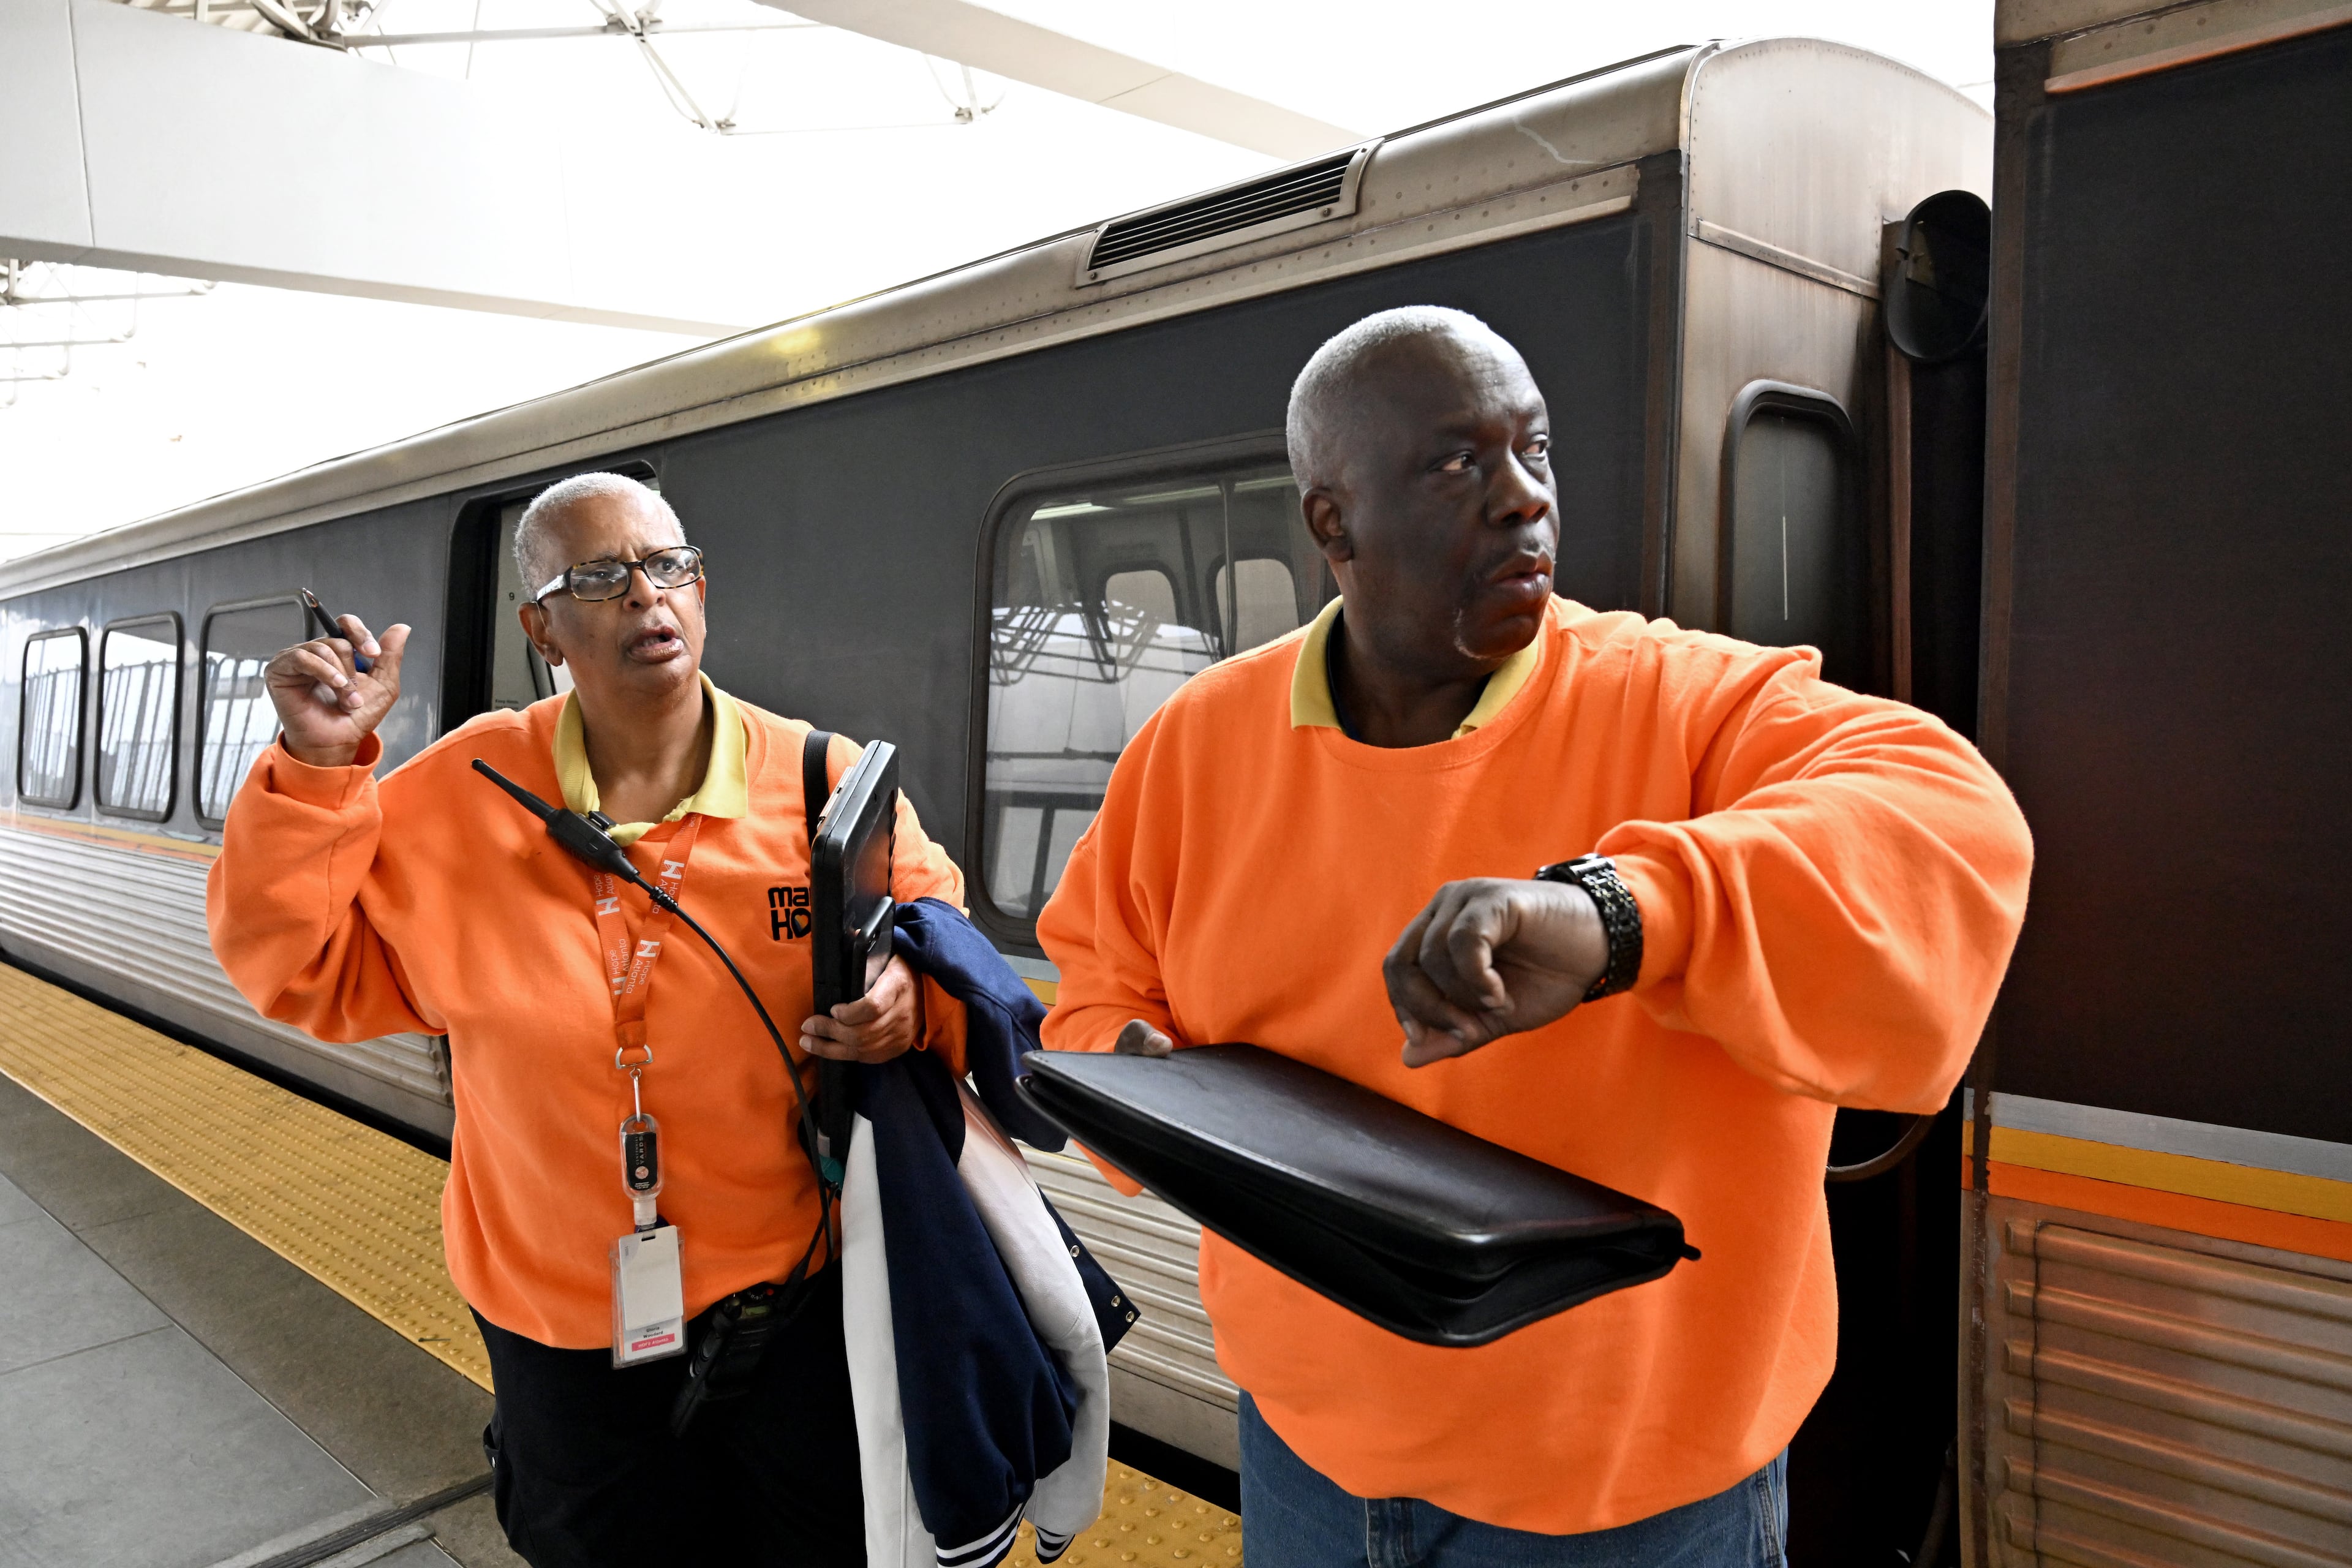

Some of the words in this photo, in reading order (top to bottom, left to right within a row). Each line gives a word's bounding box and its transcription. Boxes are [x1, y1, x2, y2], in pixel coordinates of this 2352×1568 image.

[509, 592, 514, 601] 9
[594, 875, 604, 897] Hope
[605, 873, 615, 894] Atlan
[767, 887, 810, 908] ma
[609, 950, 620, 975] Hope
[619, 938, 630, 972] Atlanta
[626, 959, 643, 993] Atlanta
[639, 960, 651, 985] Hope
